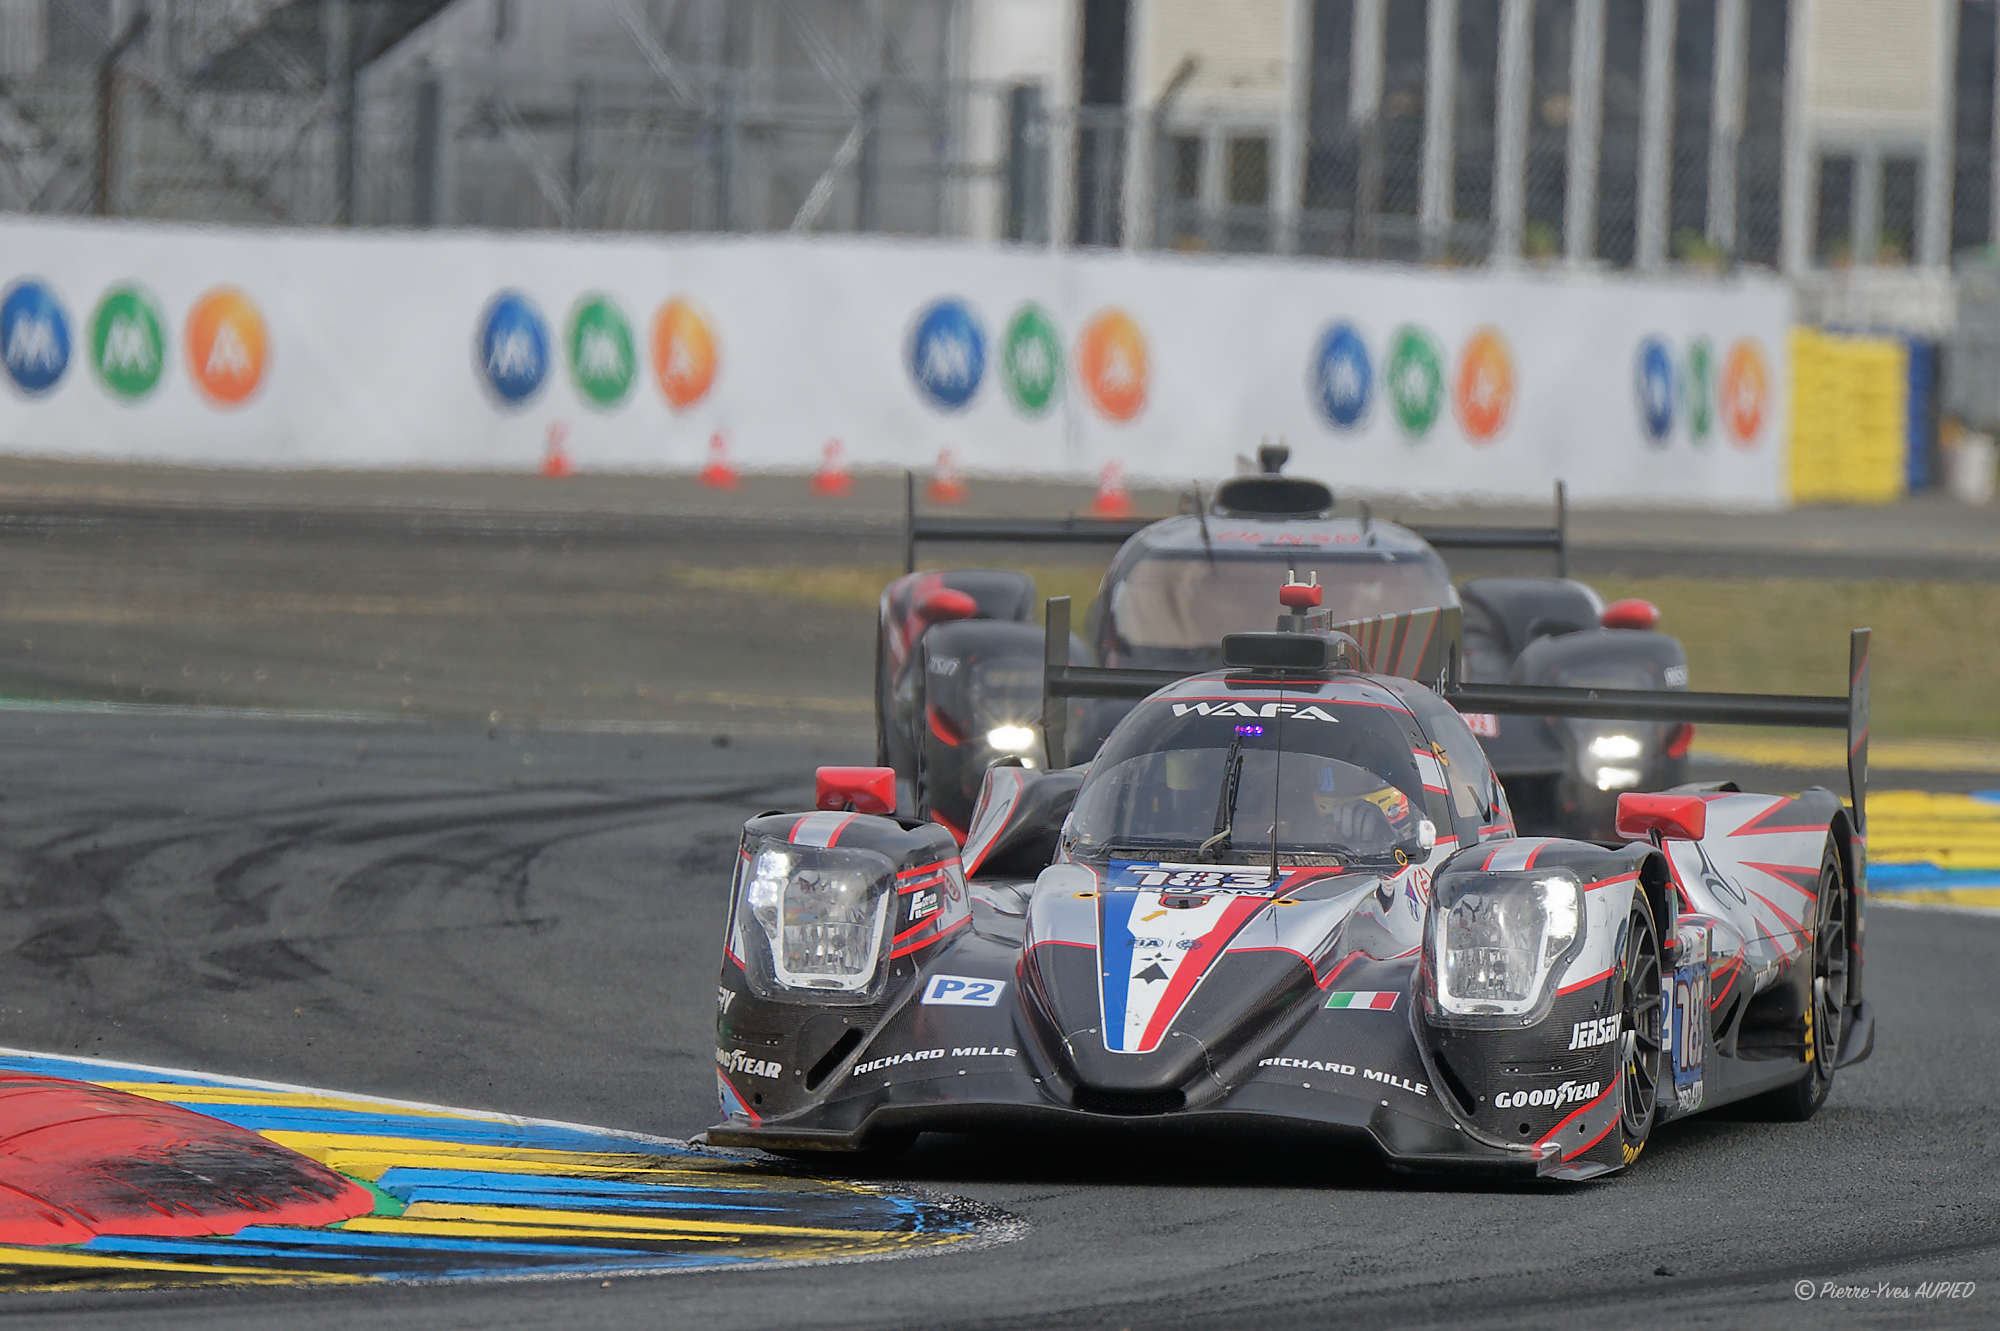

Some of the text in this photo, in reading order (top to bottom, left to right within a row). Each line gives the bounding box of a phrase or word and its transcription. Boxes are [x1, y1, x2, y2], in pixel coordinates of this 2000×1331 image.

[1171, 701, 1339, 723] WAFA
[932, 979, 996, 1001] P2
[853, 1047, 1018, 1077] RICHARD MILLE
[1258, 1057, 1429, 1096] RICHARD MILLE
[1494, 1080, 1601, 1110] GOODYEAR
